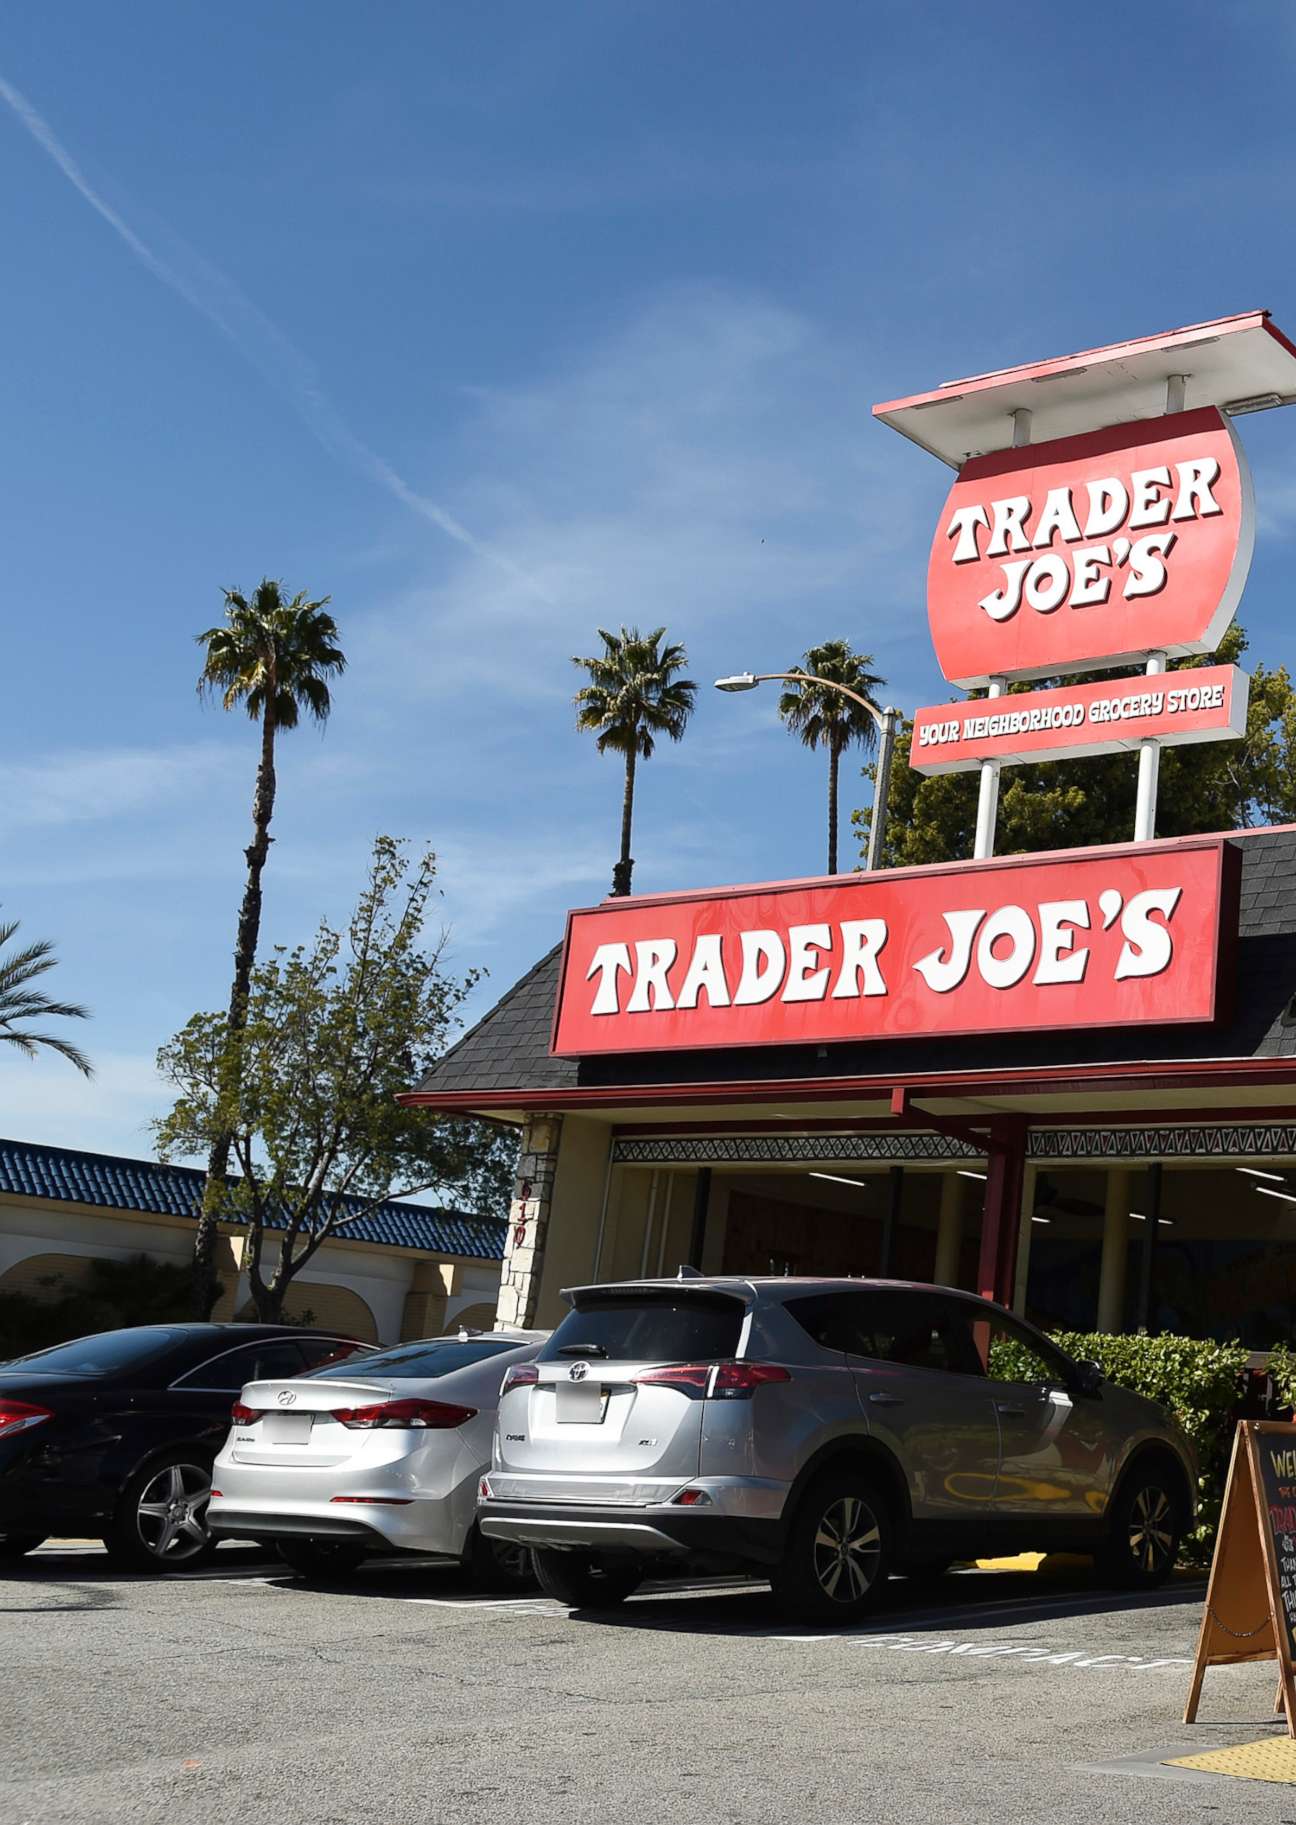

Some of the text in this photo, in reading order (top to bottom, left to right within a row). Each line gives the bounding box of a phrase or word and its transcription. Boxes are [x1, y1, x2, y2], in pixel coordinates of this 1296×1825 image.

[946, 457, 1223, 566] TRADER
[978, 532, 1178, 623] JOE'S
[919, 685, 1225, 746] YOUR NEIGHBORHOOD GROCERY STORE
[586, 887, 1183, 1016] TRADER JOE'S
[1281, 1575, 1292, 1588] ALL
[847, 1637, 1193, 1669] COMPACT
